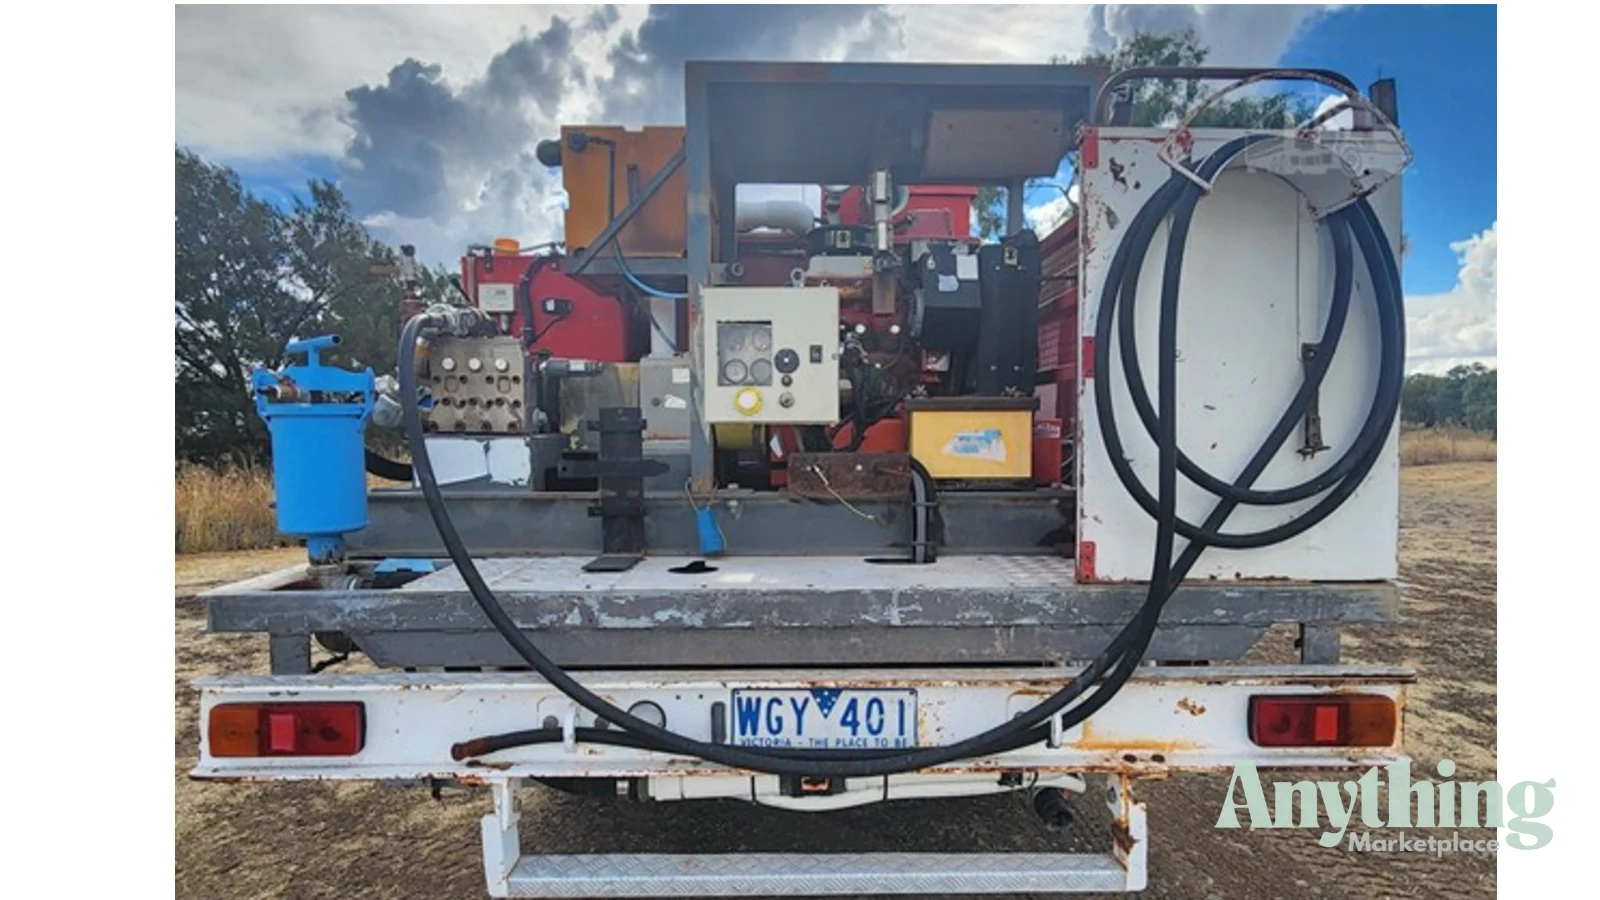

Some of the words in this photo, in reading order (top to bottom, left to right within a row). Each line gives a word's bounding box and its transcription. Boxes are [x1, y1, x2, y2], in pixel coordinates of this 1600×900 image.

[737, 696, 809, 736] WGY
[840, 697, 905, 736] 401
[740, 737, 791, 747] VICTORIA
[808, 737, 828, 747] THE
[836, 737, 867, 747] PLACE
[874, 737, 888, 747] TO
[895, 737, 908, 747] BE
